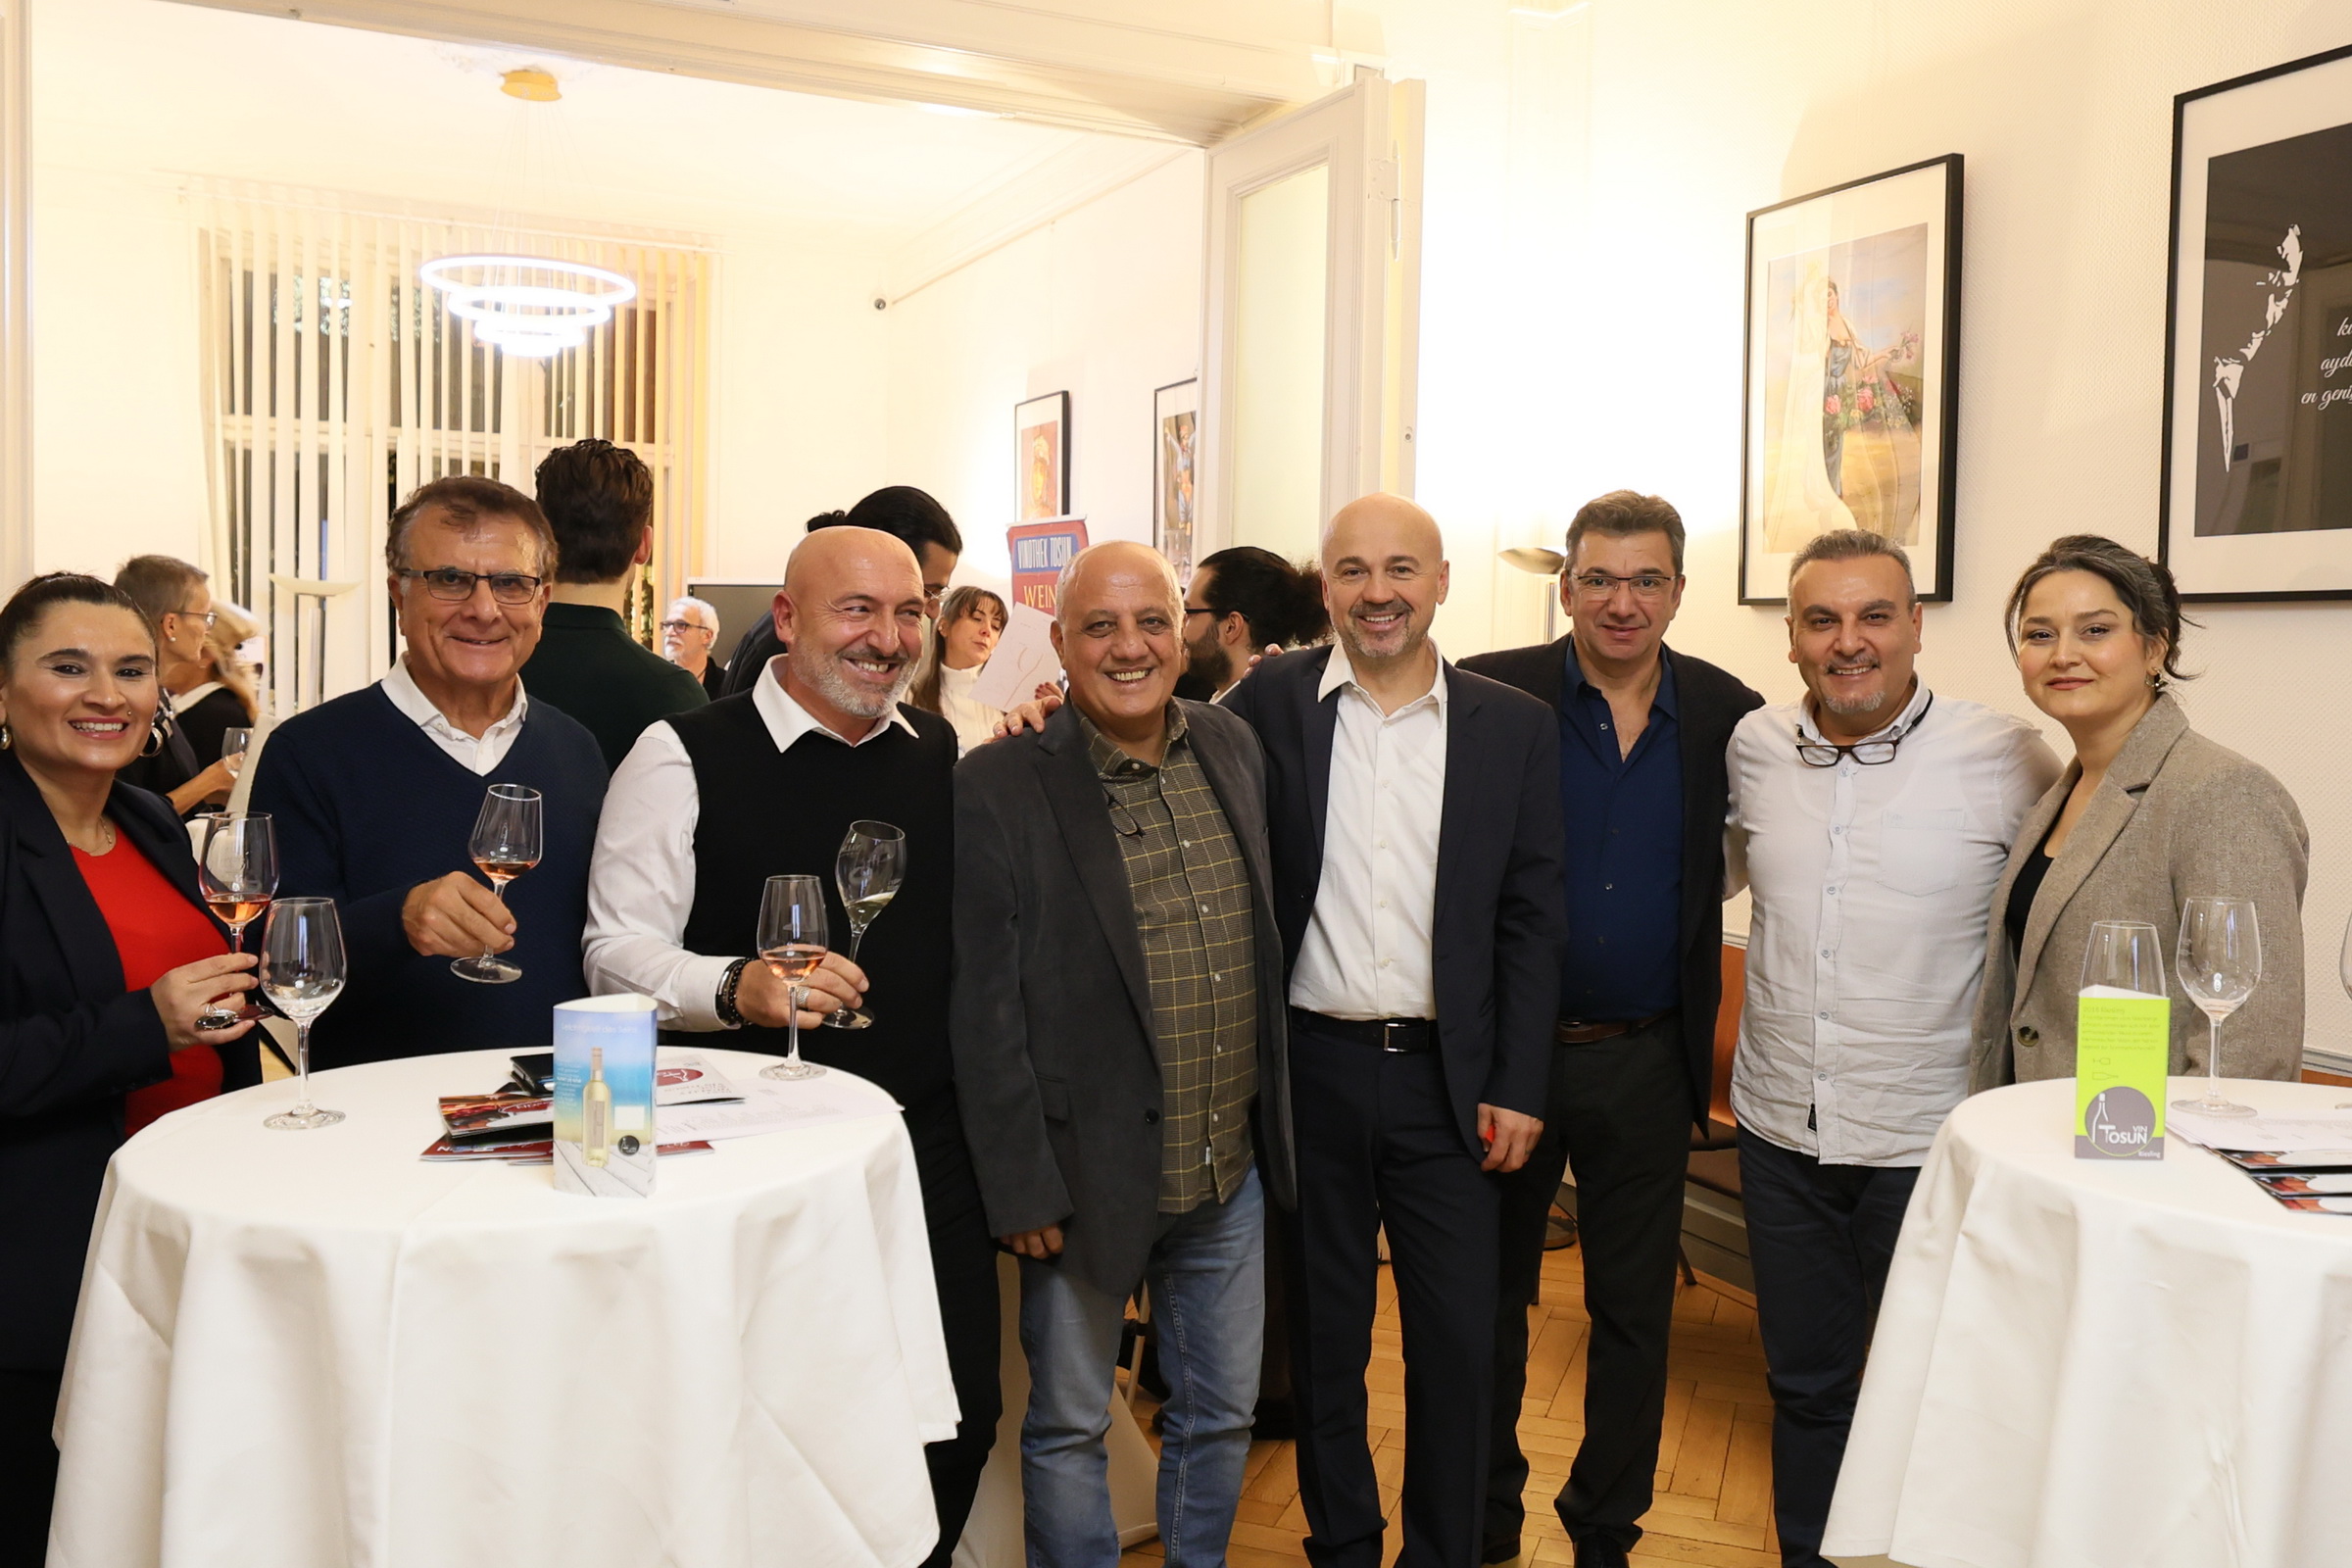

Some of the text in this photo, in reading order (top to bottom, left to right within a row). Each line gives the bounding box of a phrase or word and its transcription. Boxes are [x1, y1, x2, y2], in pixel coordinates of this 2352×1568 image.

[2301, 392, 2318, 404] en
[1017, 536, 1072, 569] VINOTHEK TOSUN
[2098, 1124, 2148, 1145] TOSUN
[2132, 1125, 2148, 1134] VIN
[2137, 1151, 2161, 1159] Riesling
